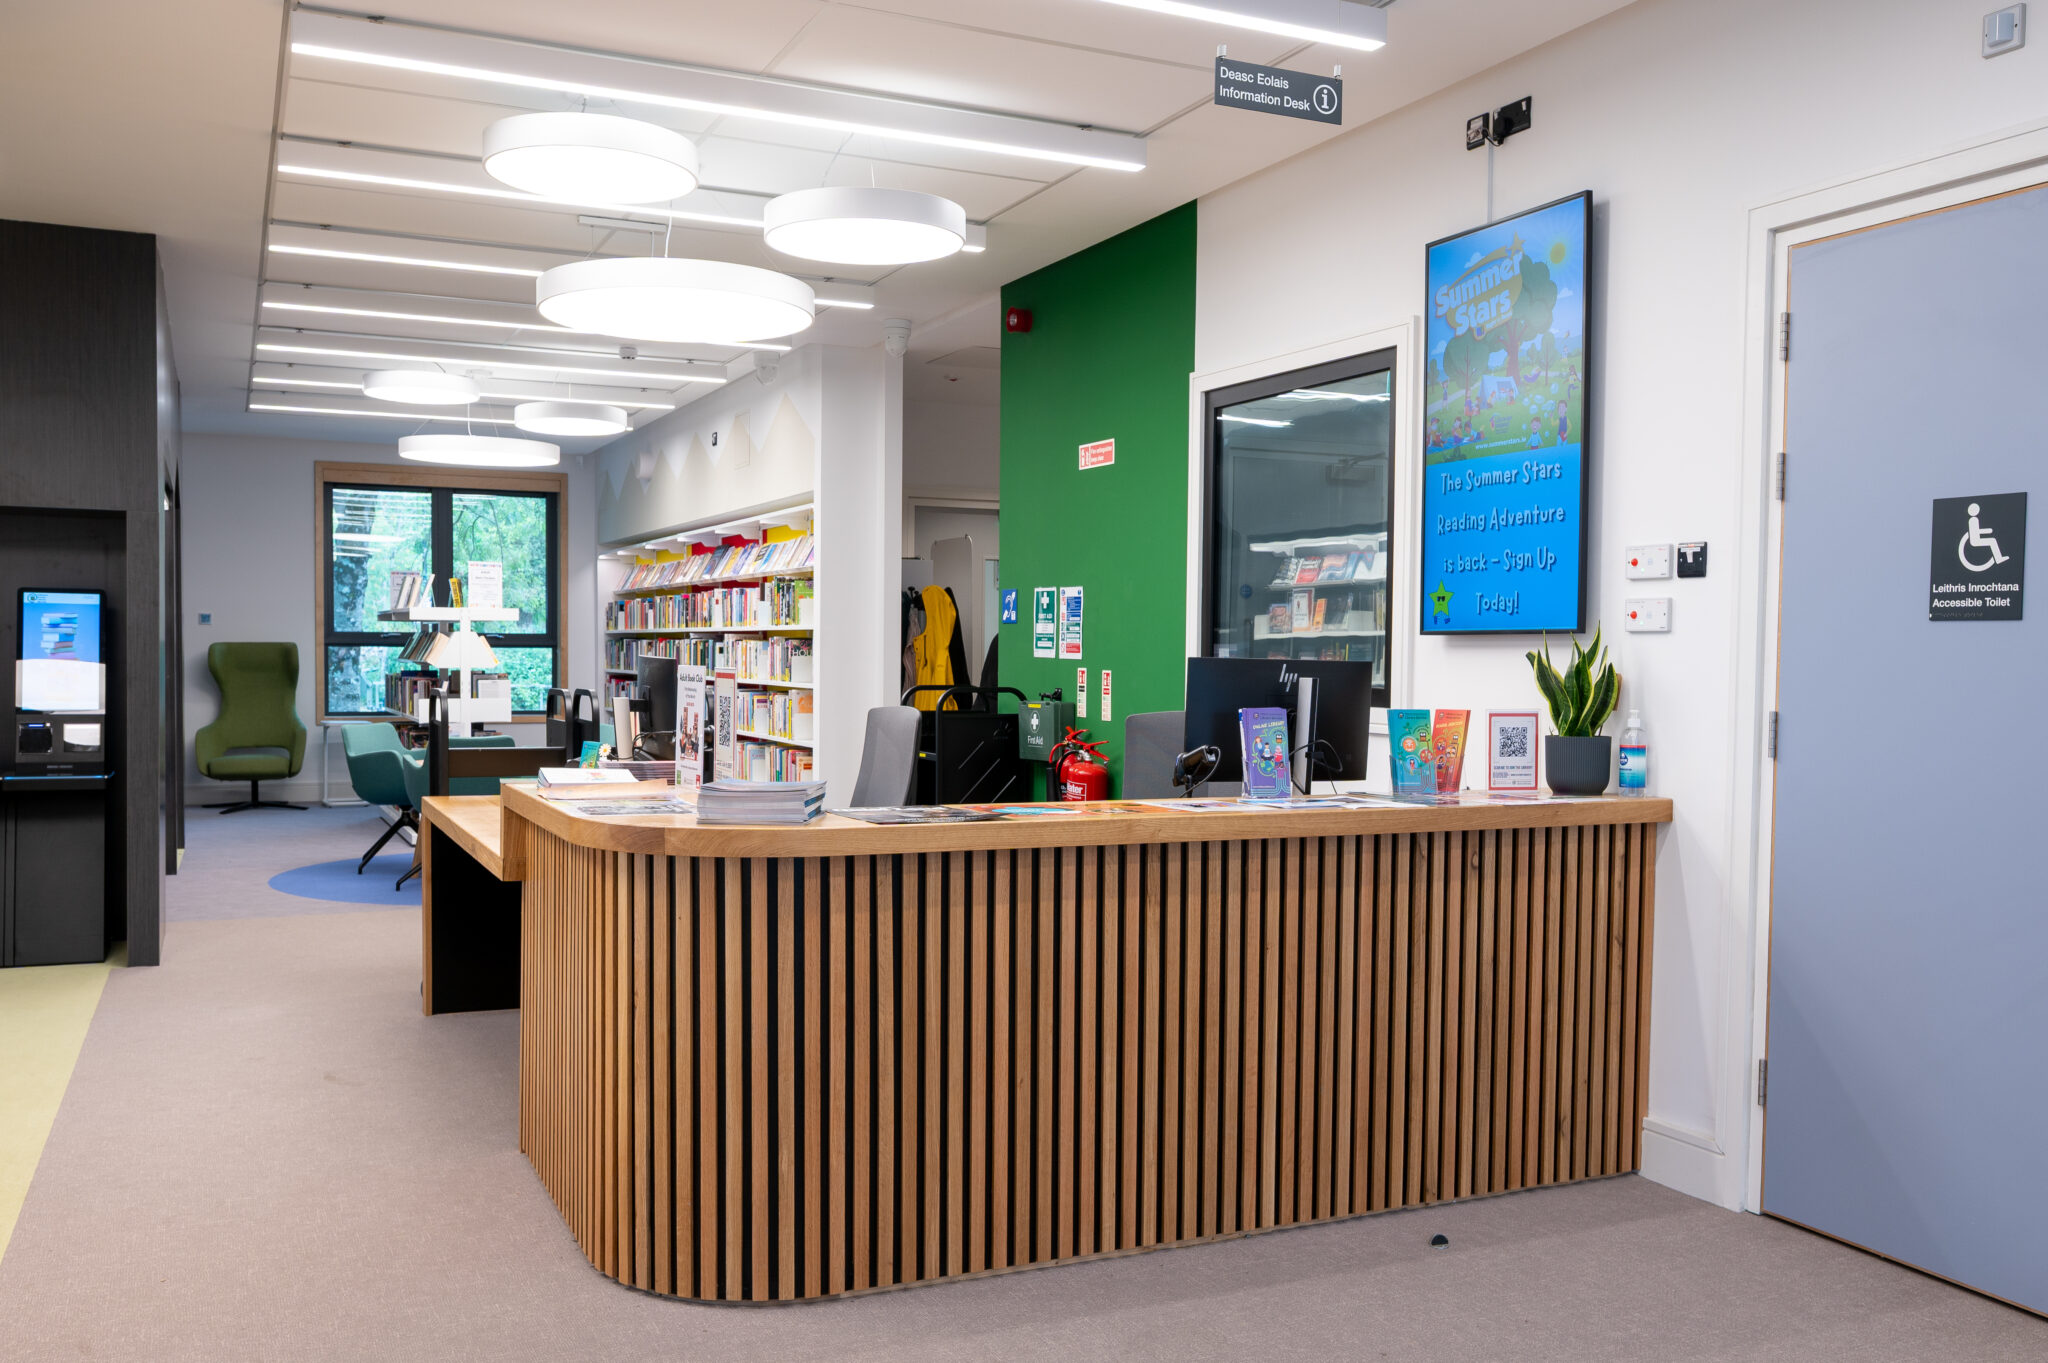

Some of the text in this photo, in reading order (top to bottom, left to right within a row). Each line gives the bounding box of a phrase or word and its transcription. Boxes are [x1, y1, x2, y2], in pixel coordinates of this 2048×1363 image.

[1220, 66, 1289, 89] Deasc Eolais
[1219, 85, 1310, 111] Information Desk
[1436, 251, 1523, 317] Summer
[1455, 289, 1512, 337] Stars
[1441, 461, 1562, 494] The Summer Stars
[1438, 504, 1565, 535] Reading Adventure
[1444, 558, 1454, 573] is
[1458, 552, 1487, 572] back
[1503, 549, 1533, 571] Sign
[1537, 546, 1556, 571] Up
[1932, 582, 2019, 593] Leithris Inrochtana
[1476, 591, 1519, 615] Today!
[1932, 597, 2010, 608] Accessible Toilet
[1279, 663, 1298, 692] hp
[1027, 735, 1036, 744] First
